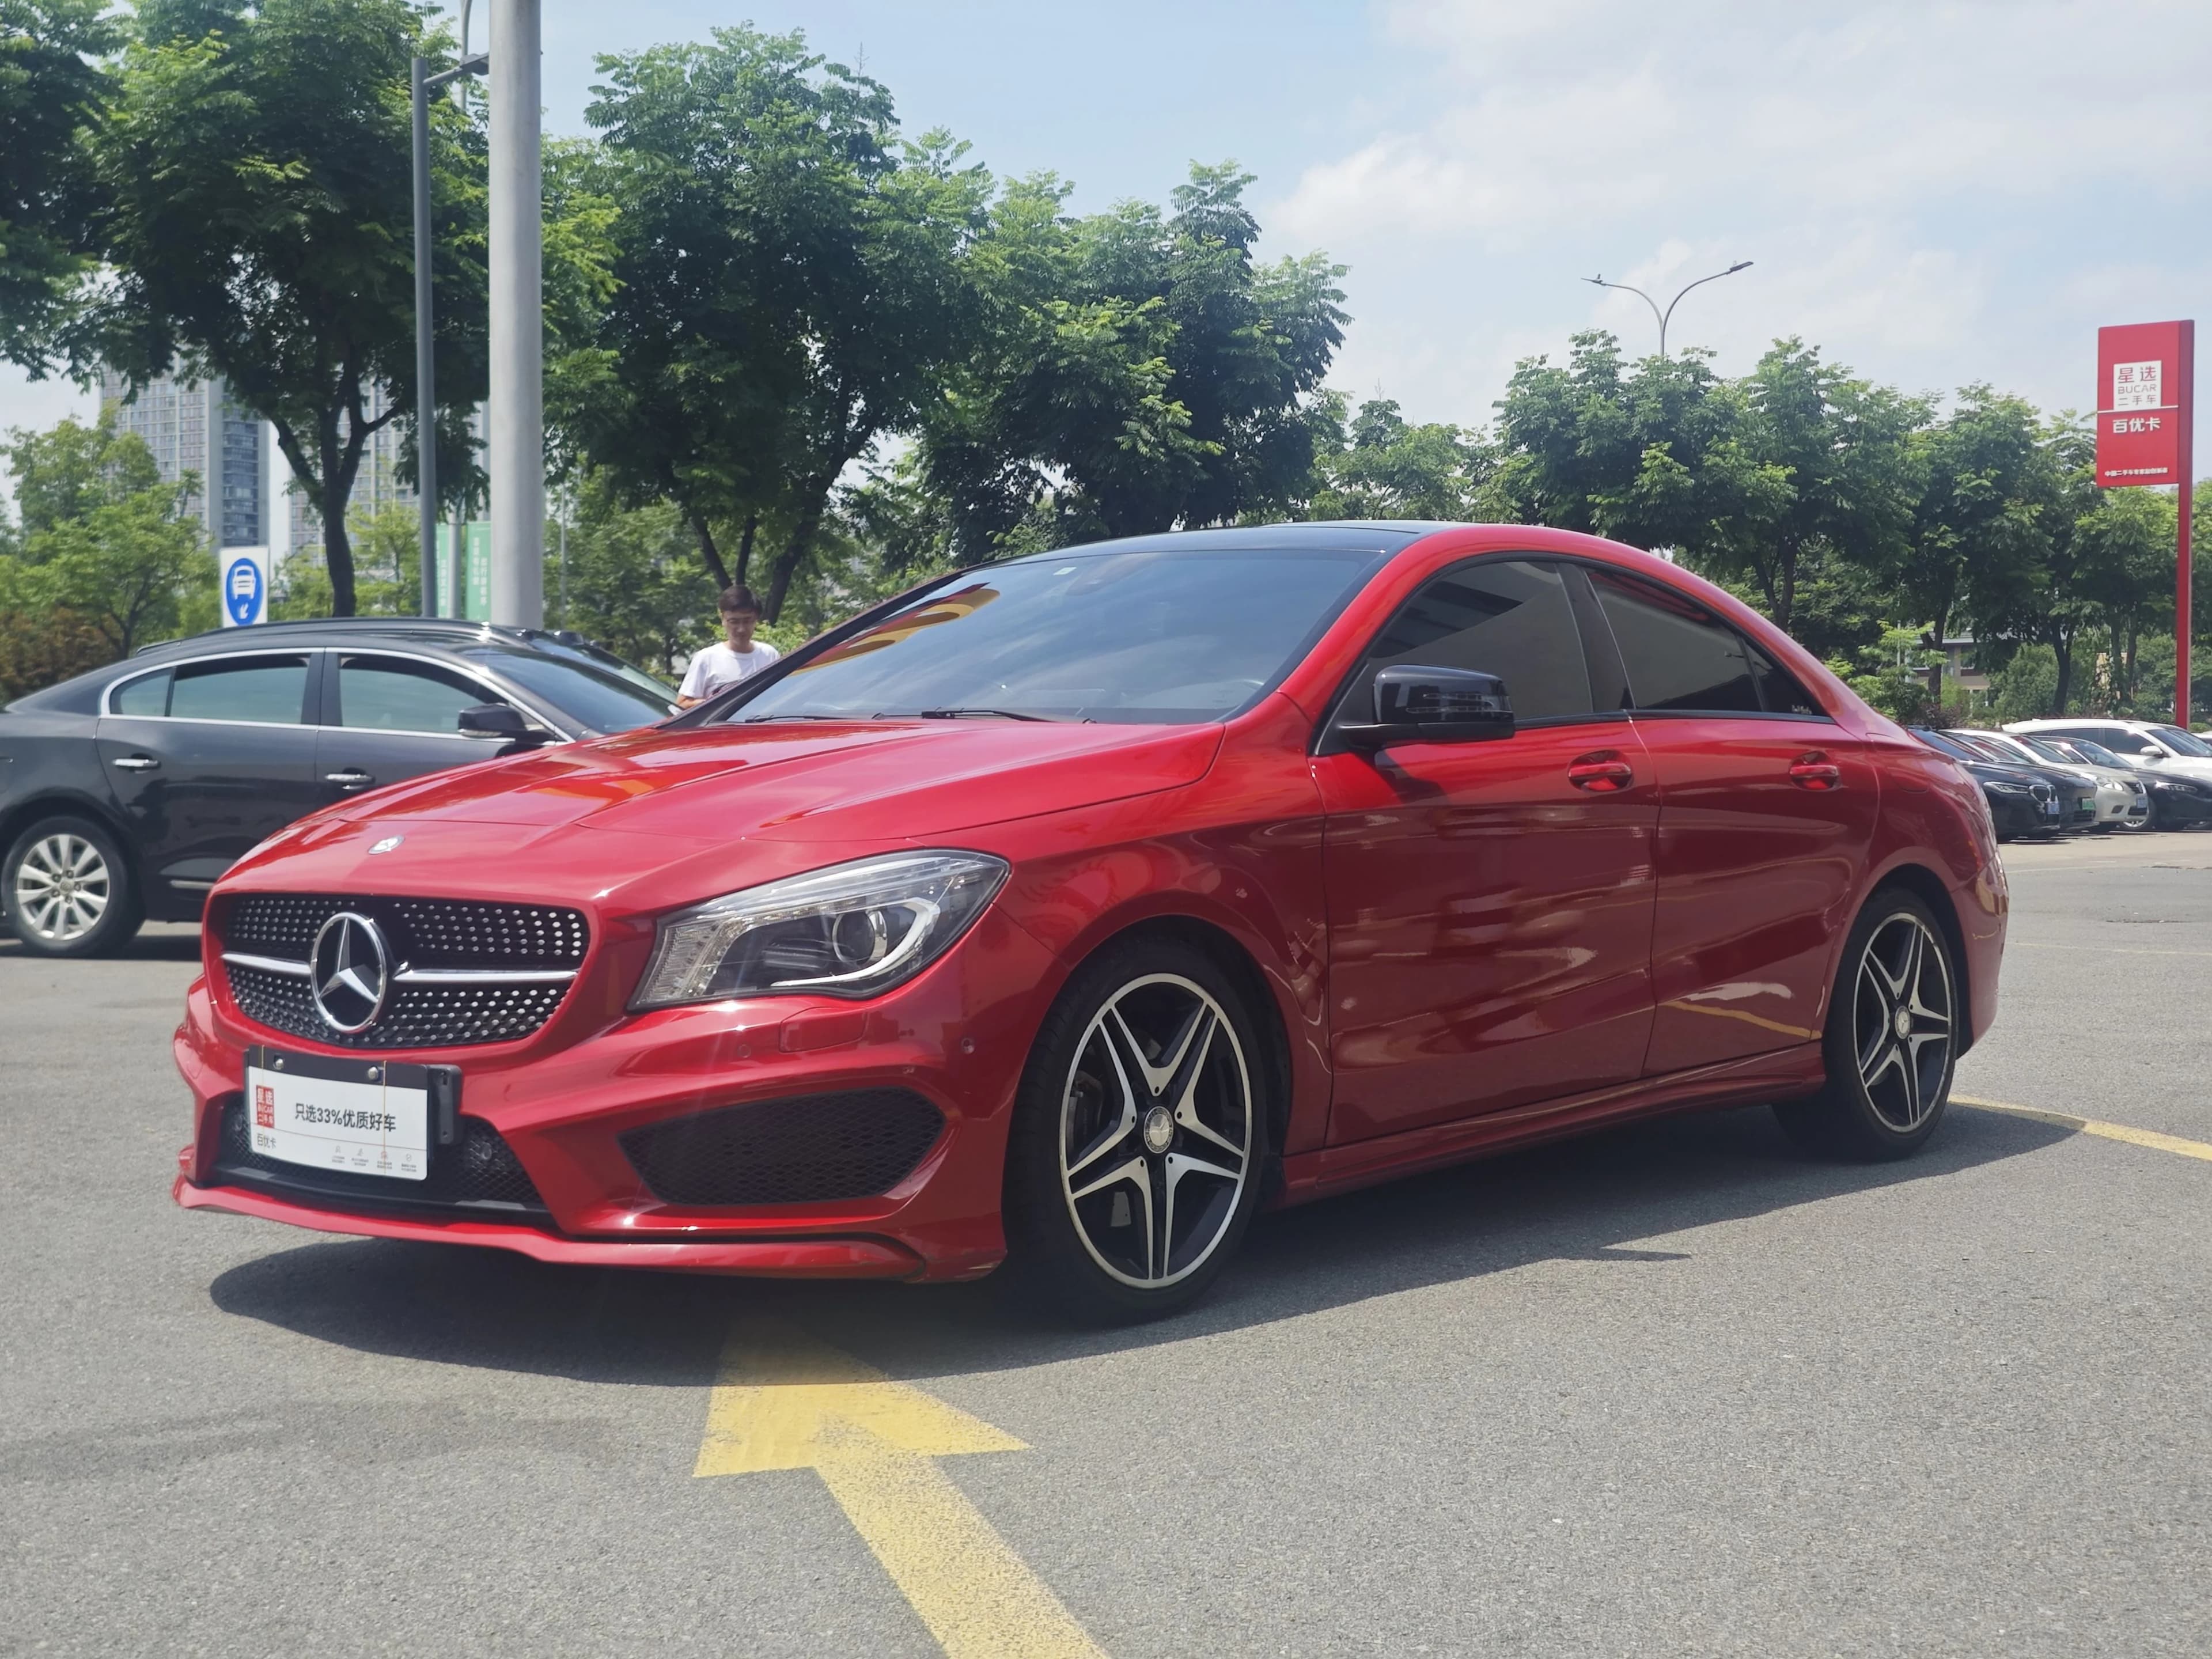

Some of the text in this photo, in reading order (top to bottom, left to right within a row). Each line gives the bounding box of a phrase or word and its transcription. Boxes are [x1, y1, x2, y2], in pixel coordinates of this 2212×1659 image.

[2118, 365, 2157, 384] 星选
[2118, 384, 2157, 395] BUCAR
[2118, 395, 2157, 406] 二手车
[2112, 417, 2161, 433] 百优卡
[295, 1103, 396, 1132] 只选33%优质好车
